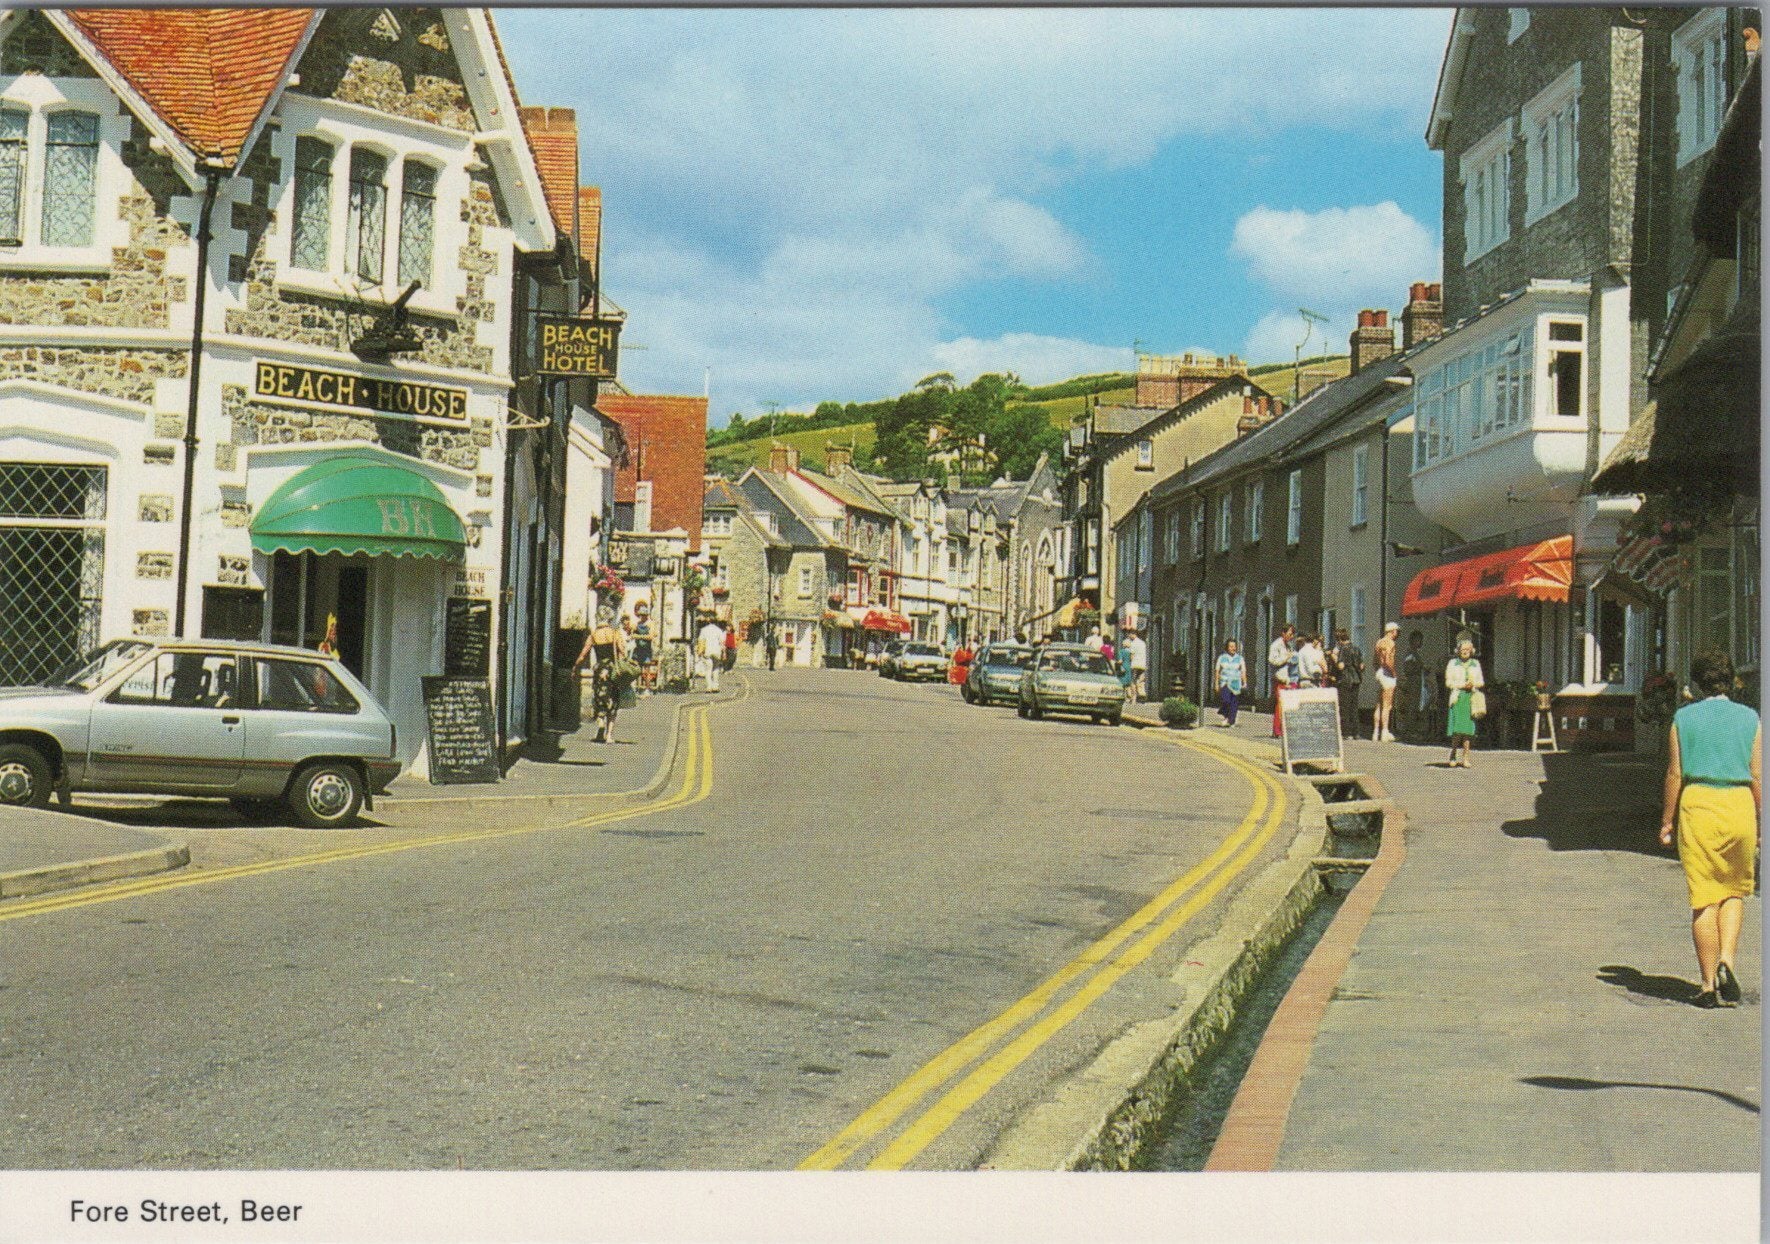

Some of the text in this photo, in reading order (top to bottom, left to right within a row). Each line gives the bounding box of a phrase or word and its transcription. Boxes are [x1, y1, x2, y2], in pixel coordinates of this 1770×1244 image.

[543, 324, 612, 350] BEACH
[554, 343, 598, 355] HOUSE
[543, 348, 609, 376] HOTEL
[257, 364, 466, 420] BEACH HOUSE
[376, 498, 437, 538] BH
